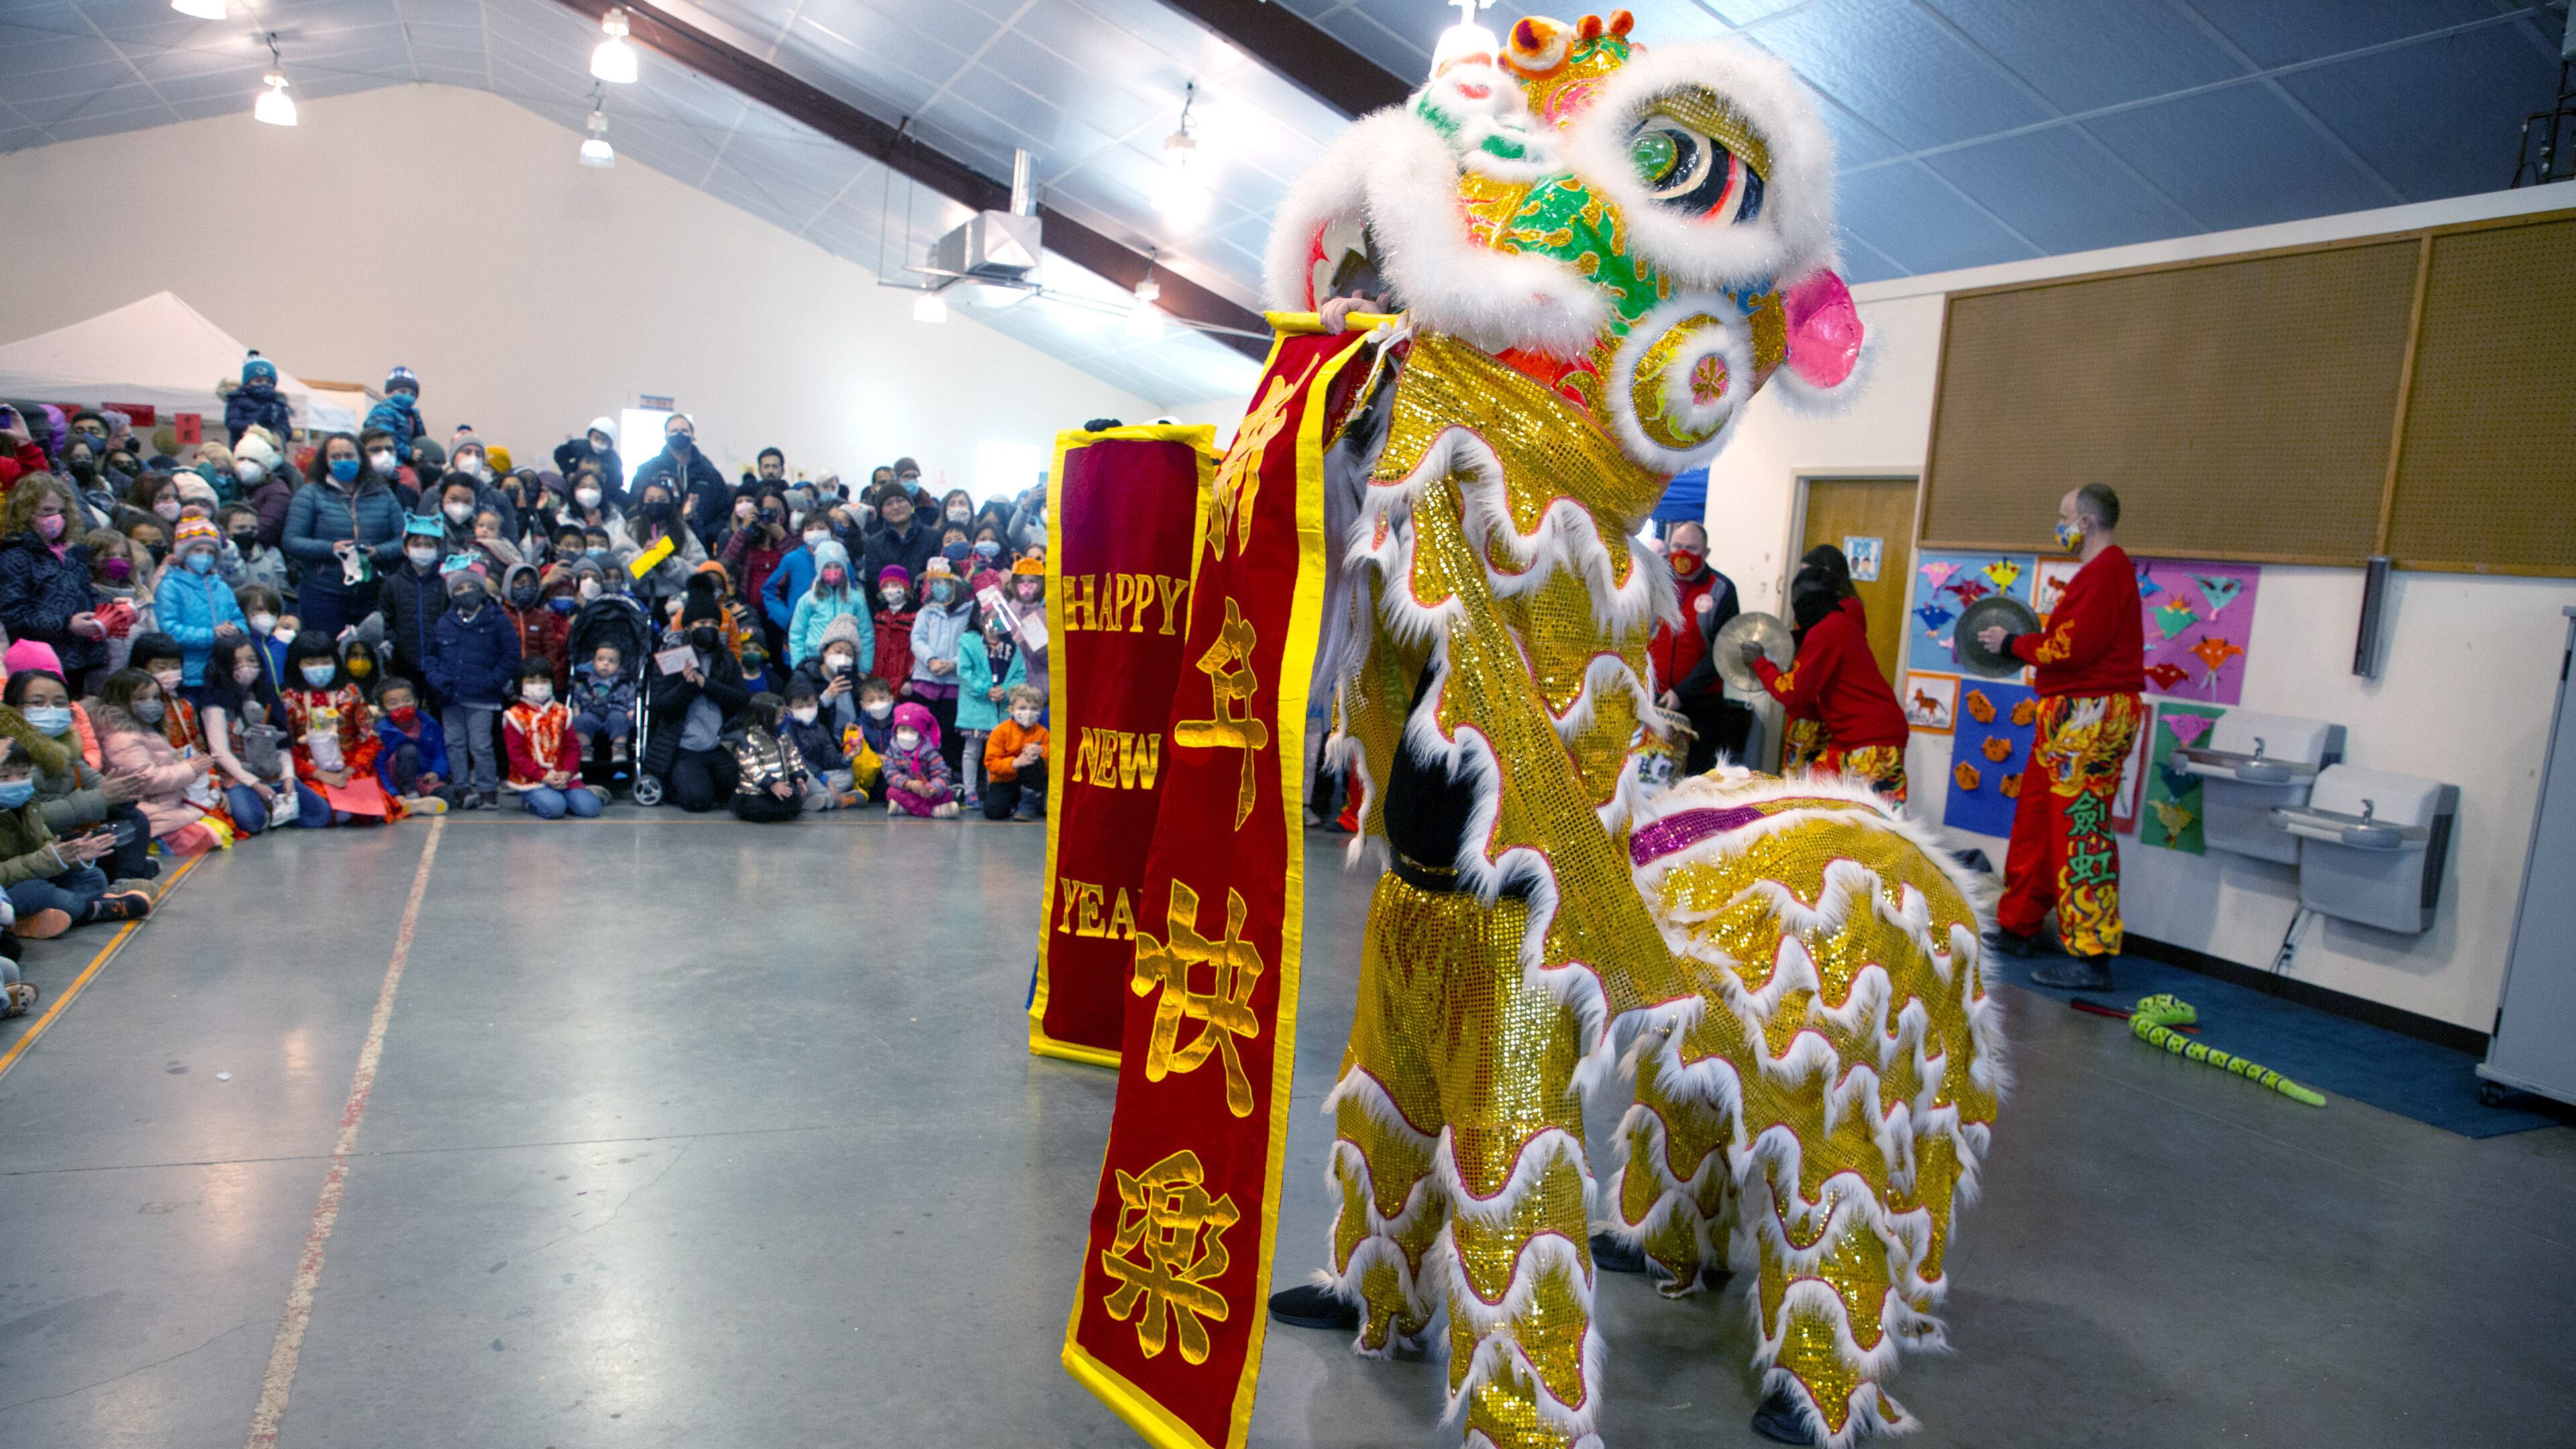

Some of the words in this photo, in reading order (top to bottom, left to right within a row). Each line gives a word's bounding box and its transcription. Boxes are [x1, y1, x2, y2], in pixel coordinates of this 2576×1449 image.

[1062, 572, 1189, 635] HAPPY
[1072, 727, 1161, 790] NEW
[1058, 877, 1143, 941] YEA
